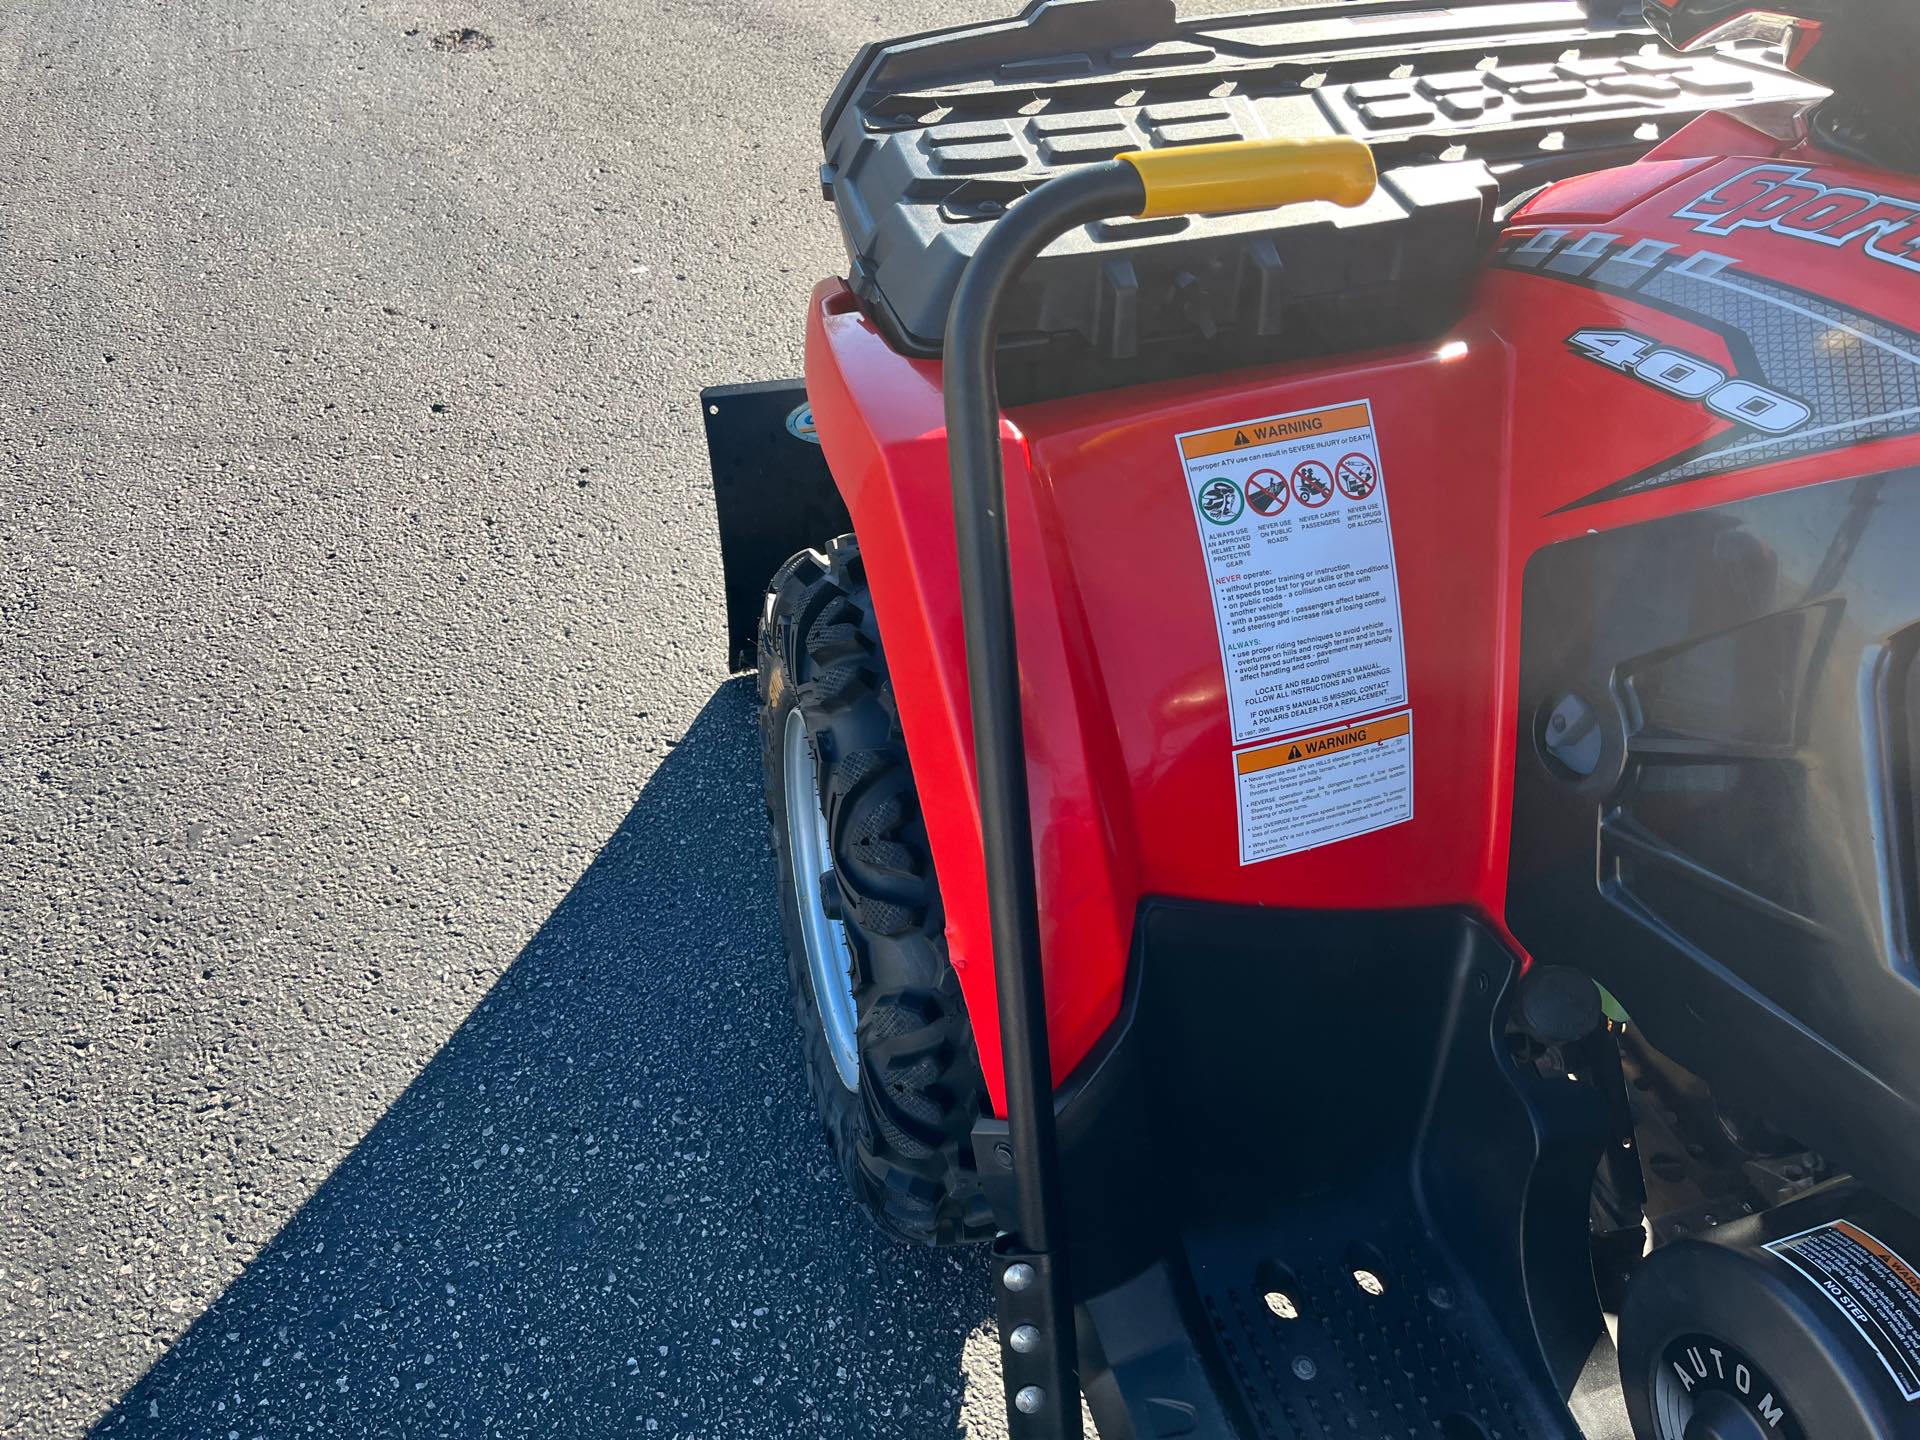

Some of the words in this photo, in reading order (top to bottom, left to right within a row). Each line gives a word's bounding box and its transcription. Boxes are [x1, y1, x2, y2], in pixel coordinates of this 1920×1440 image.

[1567, 329, 1811, 433] 400
[1254, 418, 1322, 440] WARNING
[1189, 460, 1220, 473] Improper
[1221, 458, 1235, 466] ATV
[1261, 449, 1280, 458] result
[1288, 443, 1315, 454] SEVERE
[1316, 438, 1340, 449] INJURY
[1348, 433, 1370, 443] DEATH
[1299, 513, 1319, 523] NEVER
[1320, 509, 1339, 518] CARRY
[1347, 505, 1366, 514] NEVER
[1347, 513, 1362, 522] WITH
[1364, 510, 1381, 518] DRUGS
[1257, 521, 1277, 531] NEVER
[1270, 526, 1292, 536] PUBLIC
[1301, 517, 1340, 530] PASSENGERS
[1356, 516, 1383, 527] ALCOHOL
[1208, 530, 1234, 540] ALWAYS
[1217, 534, 1250, 546] APPROVED
[1267, 535, 1288, 544] ROADS
[1211, 545, 1236, 555] HELMET
[1237, 542, 1250, 550] AND
[1213, 549, 1251, 563] PROTECTIVE
[1225, 559, 1243, 568] GEAR
[1215, 573, 1241, 585] NEVER
[1243, 568, 1272, 580] operate:
[1225, 582, 1252, 594] without
[1253, 578, 1276, 589] proper
[1278, 572, 1304, 584] training
[1314, 562, 1350, 576] instruction
[1235, 589, 1261, 601] speeds
[1274, 583, 1288, 592] fast
[1289, 581, 1299, 589] for
[1300, 578, 1315, 588] your
[1316, 574, 1334, 583] skills
[1355, 562, 1388, 576] conditions
[1239, 597, 1261, 608] public
[1262, 593, 1282, 603] roads
[1293, 584, 1322, 597] collision
[1337, 578, 1356, 587] occur
[1357, 574, 1371, 583] with
[1229, 606, 1256, 618] another
[1257, 601, 1283, 612] vehicle
[1231, 617, 1246, 626] with
[1254, 609, 1290, 623] passenger
[1295, 600, 1334, 614] passengers
[1335, 595, 1354, 605] affect
[1354, 590, 1379, 601] balance
[1232, 626, 1245, 634] and
[1246, 620, 1275, 632] steering
[1276, 617, 1289, 625] and
[1290, 610, 1320, 622] increase
[1320, 607, 1333, 616] risk
[1342, 601, 1362, 612] losing
[1364, 596, 1386, 607] control
[1226, 638, 1260, 651] ALWAYS:
[1237, 654, 1270, 667] overturns
[1282, 648, 1297, 657] hills
[1298, 644, 1311, 653] and
[1312, 640, 1332, 651] rough
[1333, 635, 1354, 646] terrain
[1355, 632, 1368, 640] and
[1376, 627, 1392, 636] turns
[1251, 646, 1274, 656] proper
[1275, 640, 1295, 651] riding
[1296, 631, 1333, 646] techniques
[1342, 626, 1360, 635] avoid
[1361, 620, 1383, 631] vehicle
[1239, 664, 1258, 674] avoid
[1259, 659, 1281, 670] paved
[1282, 653, 1311, 665] surfaces
[1316, 645, 1348, 658] pavement
[1349, 642, 1362, 651] may
[1363, 635, 1392, 648] seriously
[1239, 672, 1259, 682] affect
[1260, 665, 1290, 678] handling
[1291, 662, 1304, 671] and
[1305, 656, 1329, 668] control
[1255, 684, 1283, 695] LOCATE
[1284, 680, 1299, 689] AND
[1300, 675, 1319, 685] READ
[1320, 668, 1351, 680] OWNER'S
[1352, 661, 1380, 673] MANUAL.
[1244, 694, 1274, 706] FOLLOW
[1275, 690, 1289, 699] ALL
[1290, 678, 1339, 695] INSTRUCTIONS
[1340, 675, 1355, 684] AND
[1356, 666, 1391, 680] WARNINGS.
[1258, 703, 1290, 716] OWNER'S
[1291, 696, 1320, 708] MANUAL
[1329, 688, 1357, 700] MISSING,
[1359, 680, 1389, 692] CONTACT
[1258, 712, 1289, 724] POLARIS
[1290, 705, 1318, 717] DEALER
[1319, 702, 1333, 710] FOR
[1340, 688, 1387, 705] REPLACEMENT.
[1305, 729, 1366, 754] WARNING
[1824, 1280, 1841, 1295] NO
[1840, 1296, 1868, 1321] STEP
[1896, 1289, 1908, 1299] not
[1844, 1276, 1861, 1289] RPM
[1860, 1290, 1877, 1308] which
[1876, 1308, 1889, 1320] can
[1888, 1322, 1905, 1340] result
[1895, 1310, 1913, 1329] Doing
